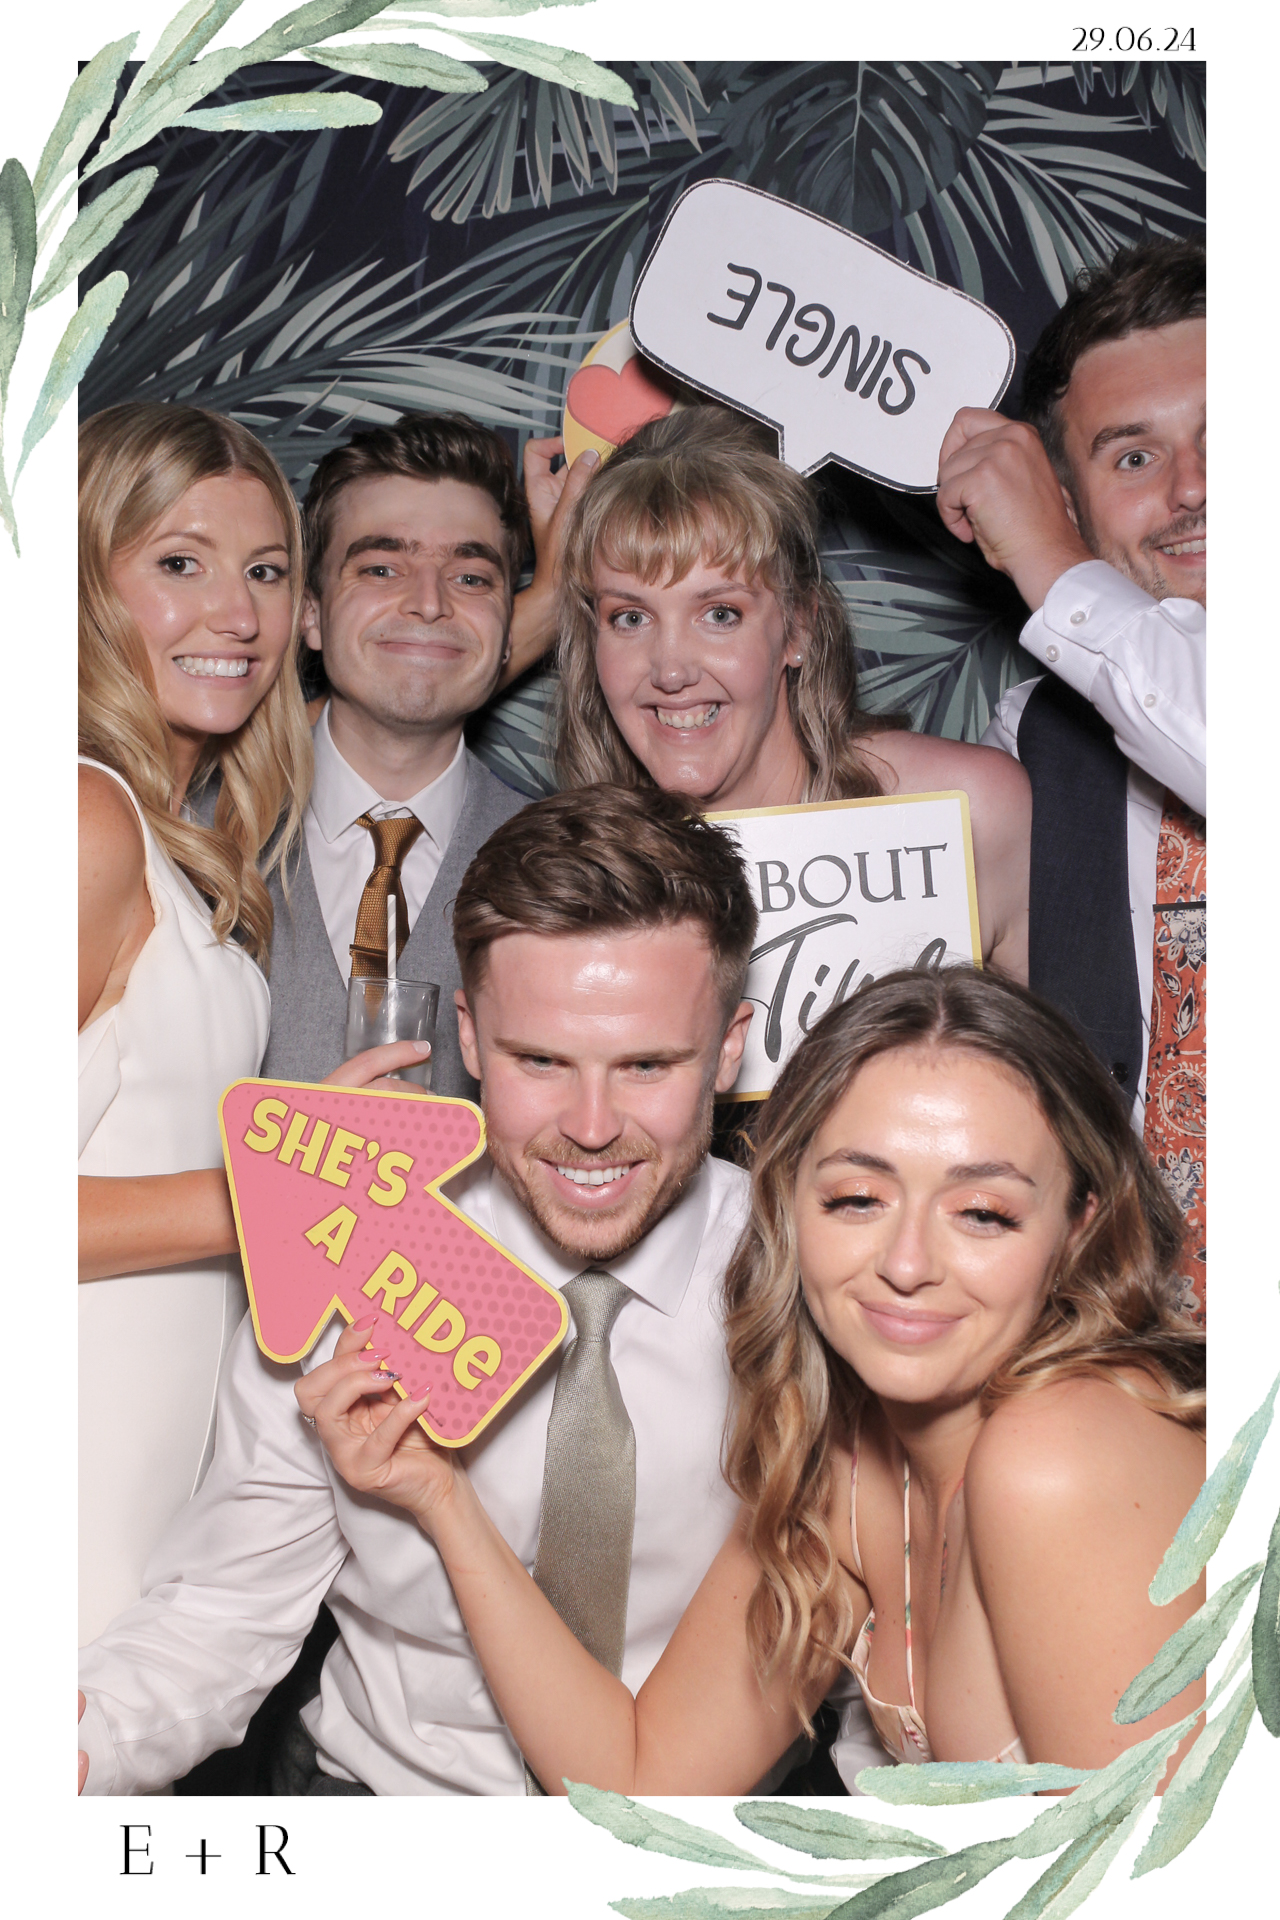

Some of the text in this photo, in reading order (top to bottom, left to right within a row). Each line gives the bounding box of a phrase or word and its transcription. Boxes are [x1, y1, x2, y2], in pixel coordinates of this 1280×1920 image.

[706, 262, 931, 416] SINGLE
[755, 842, 948, 914] BOUT
[740, 913, 947, 1063] Ti
[243, 1098, 415, 1207] SHE'S
[304, 1204, 358, 1266] A
